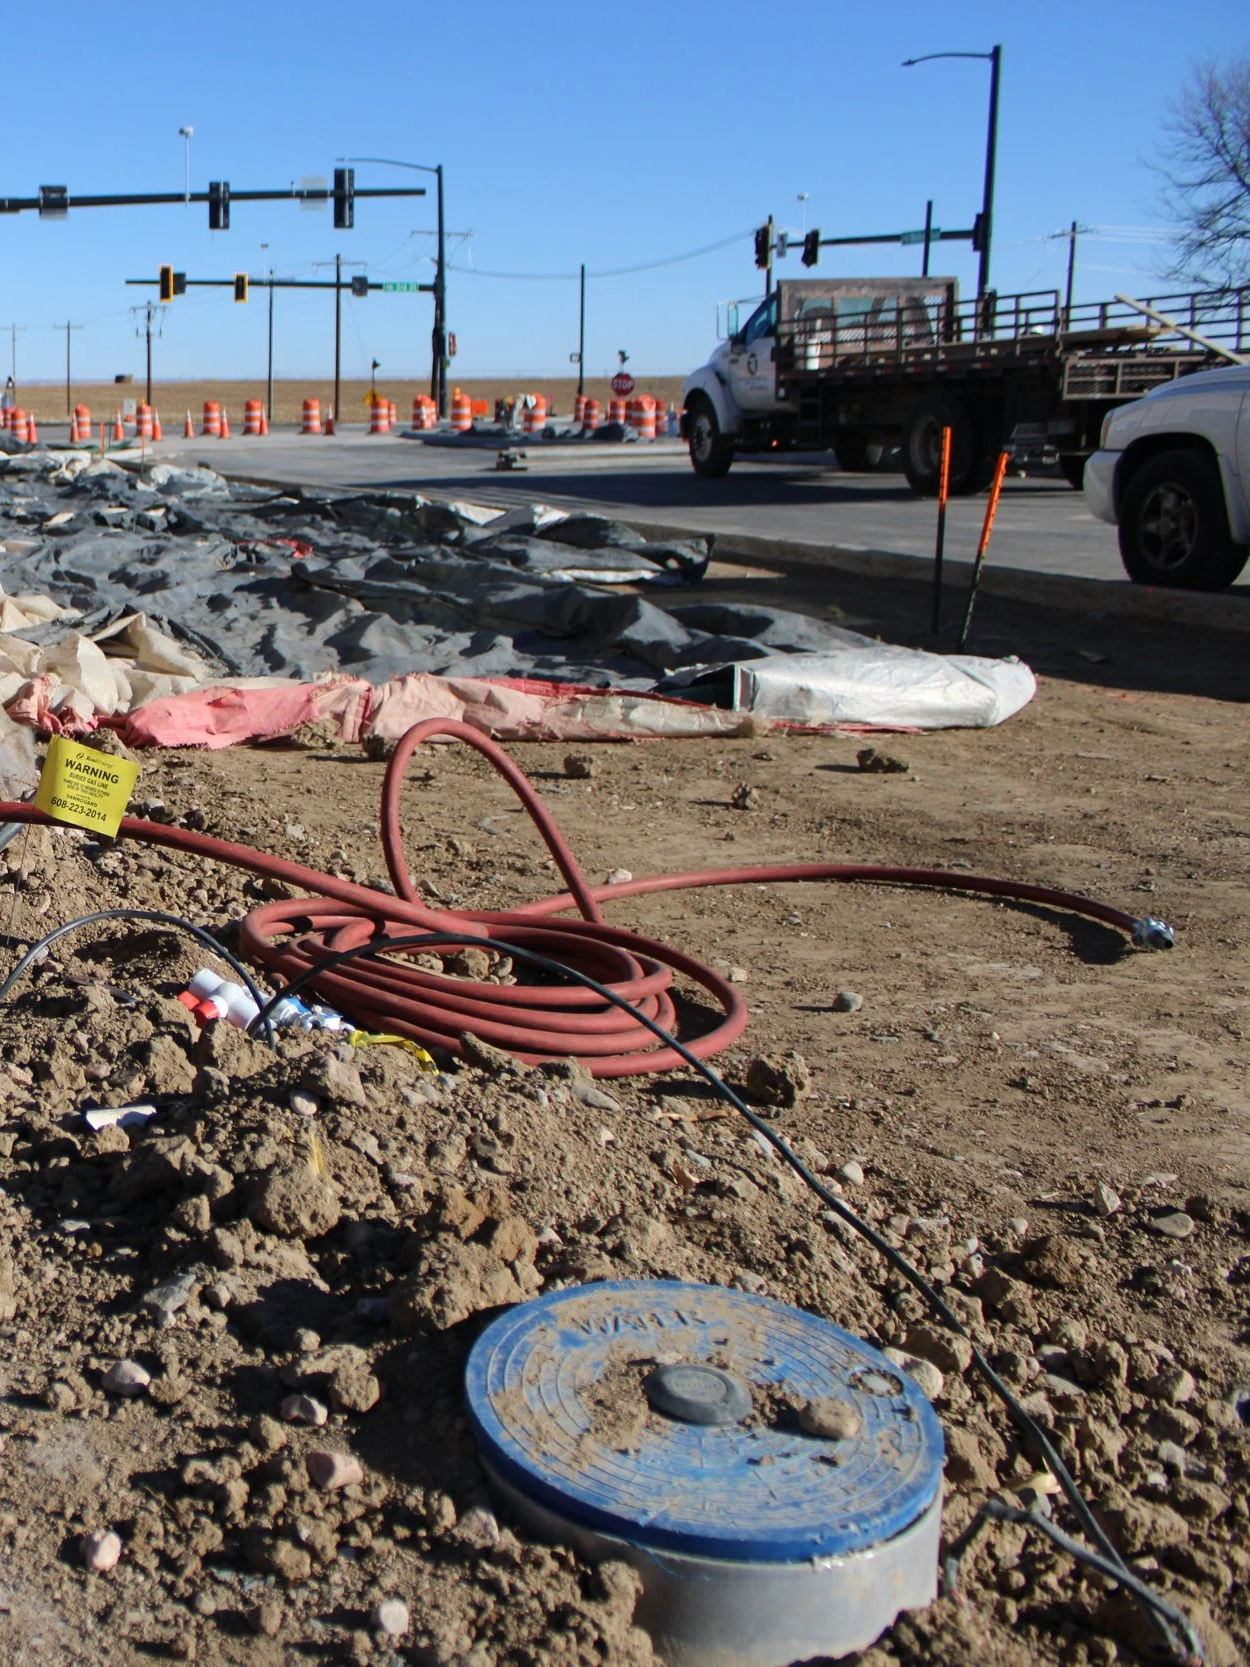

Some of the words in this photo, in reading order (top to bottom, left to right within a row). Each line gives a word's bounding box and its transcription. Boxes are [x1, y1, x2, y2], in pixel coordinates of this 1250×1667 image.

[613, 379, 633, 390] STOP
[65, 758, 119, 784] WARNING
[69, 772, 86, 782] BURIED
[86, 777, 96, 785] GAS
[96, 780, 108, 789] LINE
[51, 797, 107, 821] 608-223-2014
[571, 1309, 706, 1336] WATER
